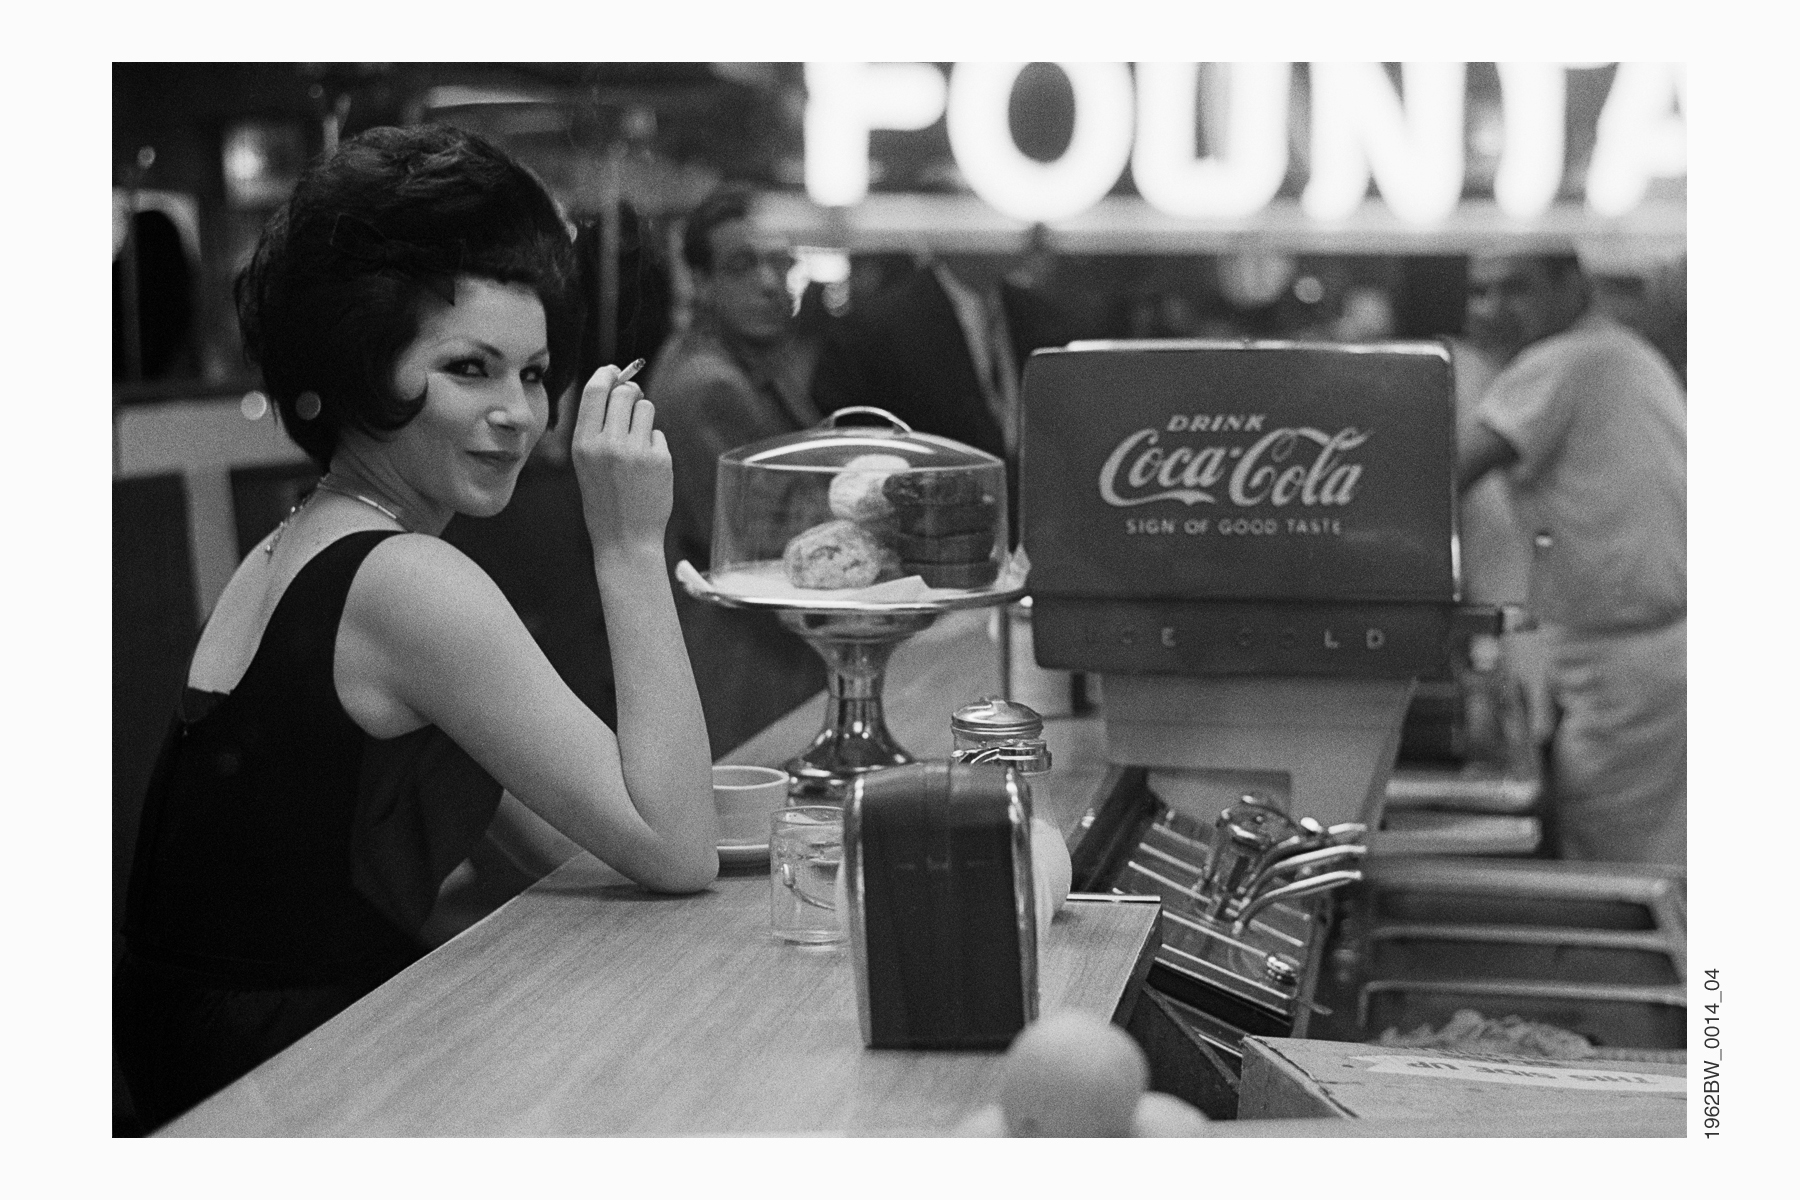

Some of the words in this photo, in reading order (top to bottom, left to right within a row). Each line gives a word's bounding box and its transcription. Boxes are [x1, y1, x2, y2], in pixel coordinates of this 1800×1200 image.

[1166, 414, 1267, 432] DRINK
[1099, 426, 1377, 507] Coca-Cola
[1125, 517, 1176, 535] SIGN
[1183, 518, 1210, 535] OF
[1217, 518, 1279, 535] GOOD
[1286, 517, 1342, 535] TASTE
[1406, 1060, 1460, 1071] UP
[1467, 1064, 1558, 1079] SIDE
